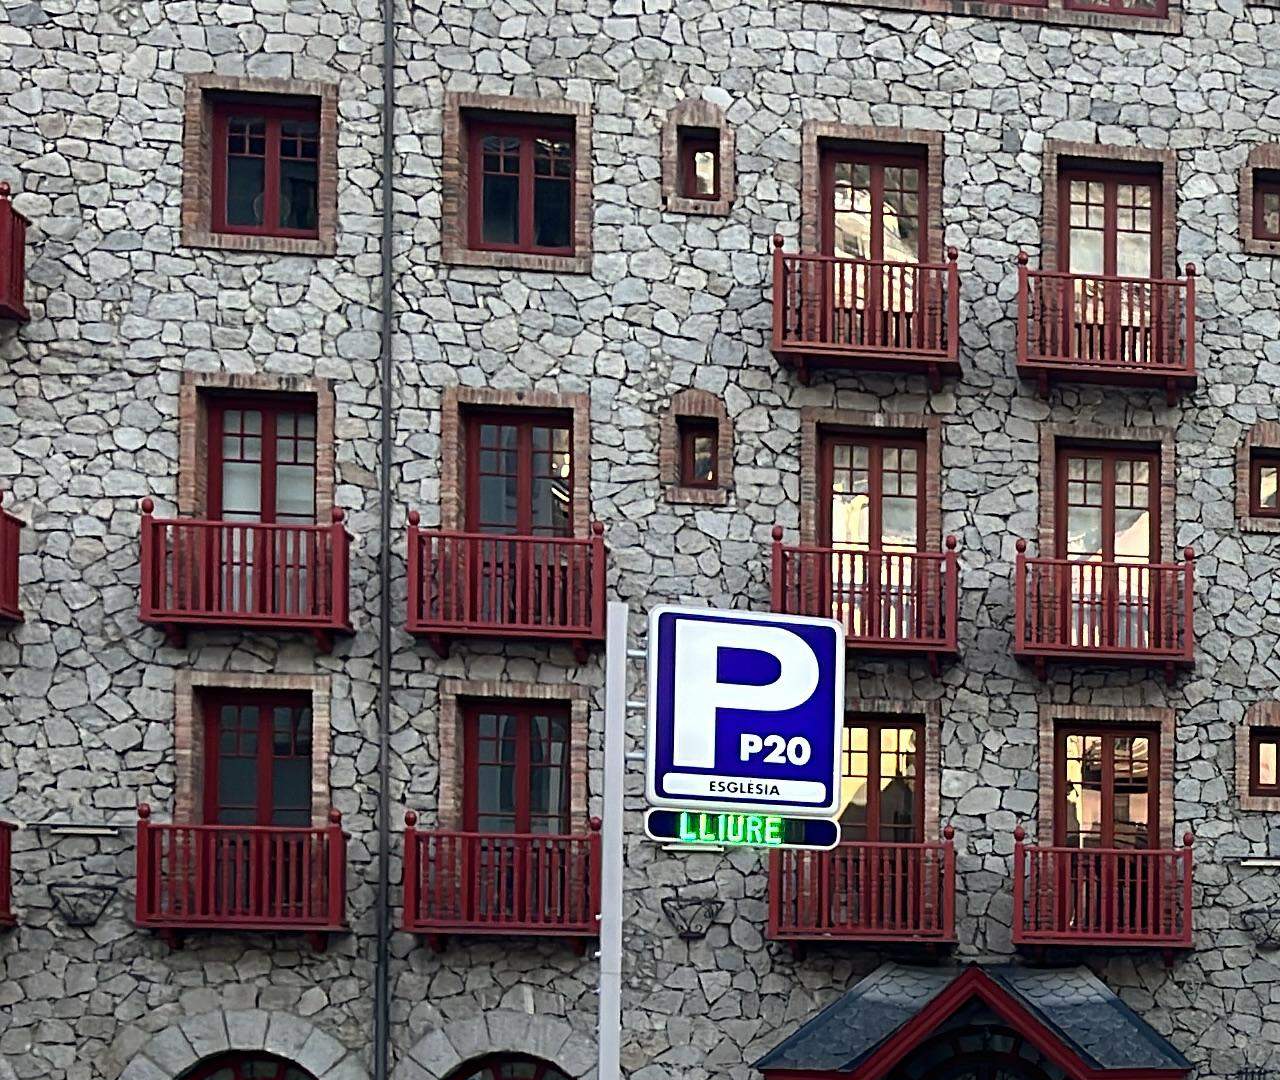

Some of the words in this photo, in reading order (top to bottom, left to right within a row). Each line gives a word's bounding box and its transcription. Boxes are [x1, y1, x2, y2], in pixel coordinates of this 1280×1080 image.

[673, 618, 820, 769] P
[740, 733, 812, 766] P20
[679, 811, 783, 844] LLIURE
